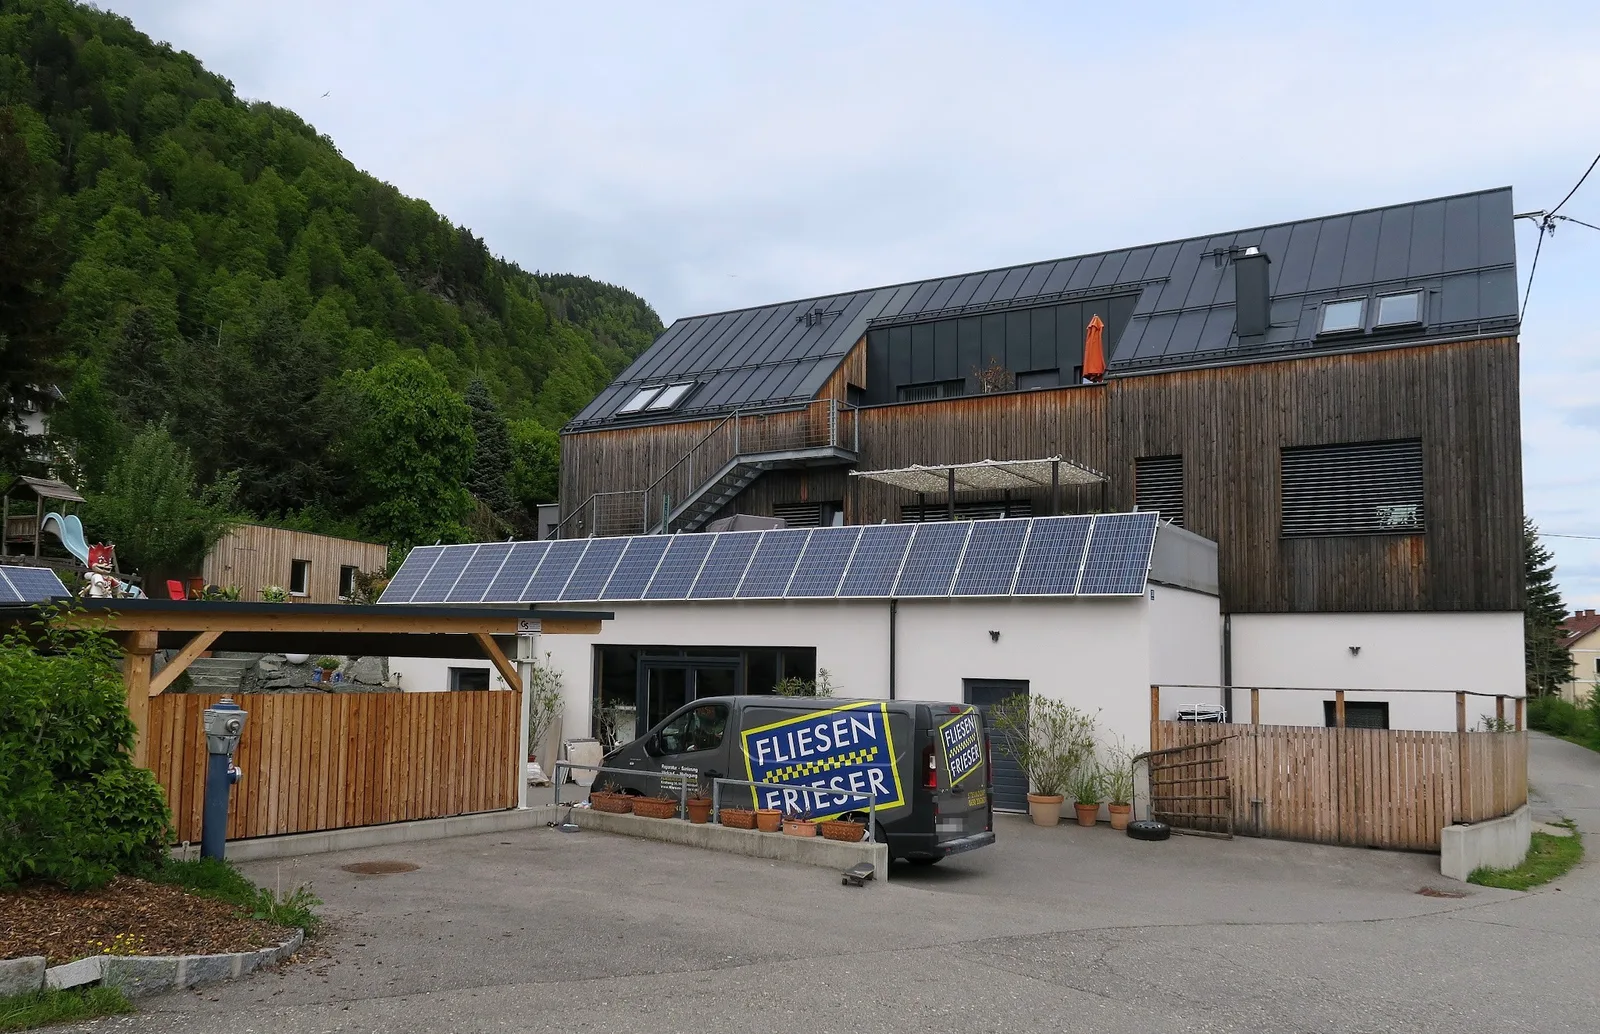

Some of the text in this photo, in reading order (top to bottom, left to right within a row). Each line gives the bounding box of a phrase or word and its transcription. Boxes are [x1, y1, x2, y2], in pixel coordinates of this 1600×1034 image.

[756, 712, 877, 766] FLIESEN
[944, 714, 976, 748] FLIESEN
[950, 743, 980, 778] FRIESER
[766, 767, 890, 816] FRIESER
